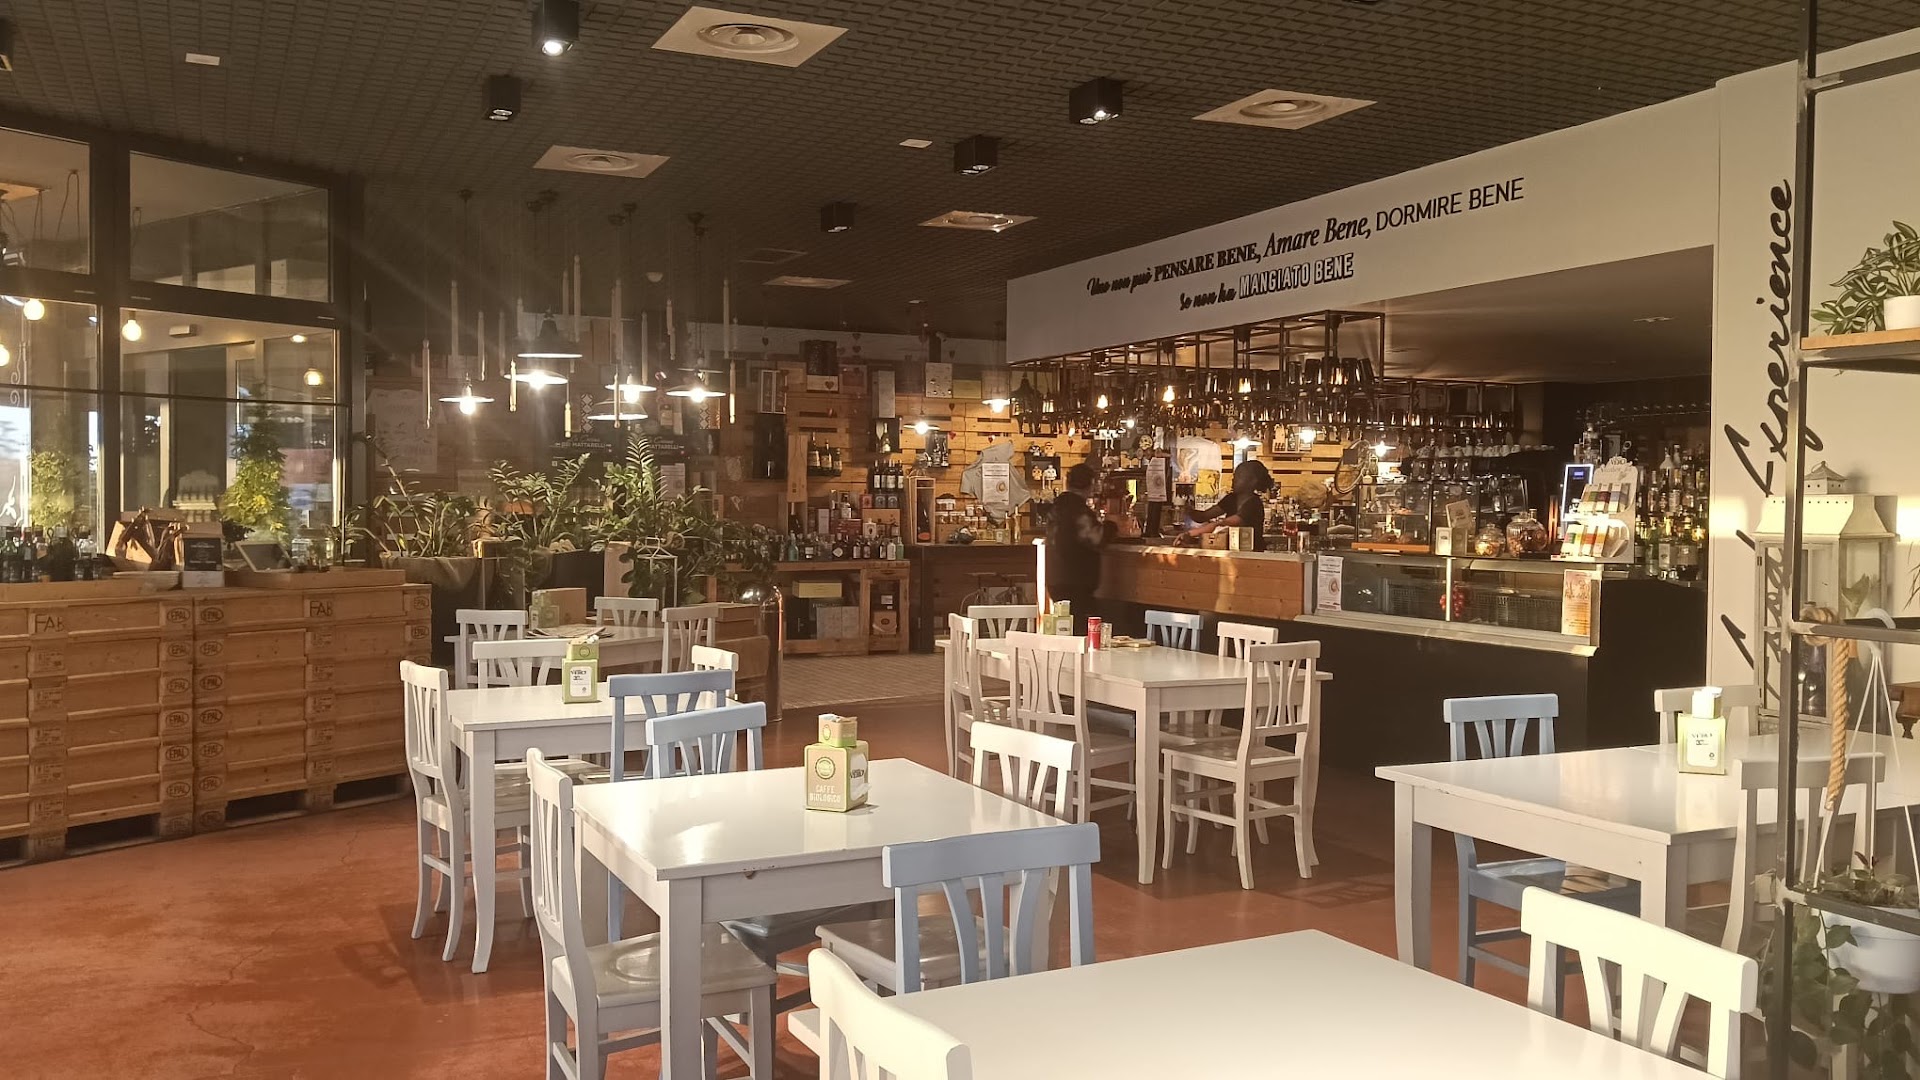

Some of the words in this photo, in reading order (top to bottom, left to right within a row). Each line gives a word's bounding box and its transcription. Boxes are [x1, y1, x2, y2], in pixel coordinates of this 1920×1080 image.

[1086, 277, 1110, 296] Uno
[1111, 278, 1131, 292] non
[1129, 267, 1153, 294] può
[1153, 253, 1215, 283] PENSARE
[1216, 242, 1262, 269] BENE,
[1263, 227, 1320, 259] Amare
[1323, 216, 1371, 244] Bene,
[1375, 192, 1463, 232] DORMIRE
[1468, 176, 1525, 211] BENE
[1193, 291, 1218, 308] non
[1217, 282, 1237, 304] ha
[1239, 261, 1311, 299] MANGIATO
[1314, 252, 1355, 285] BENE
[1723, 178, 1824, 498] Experience
